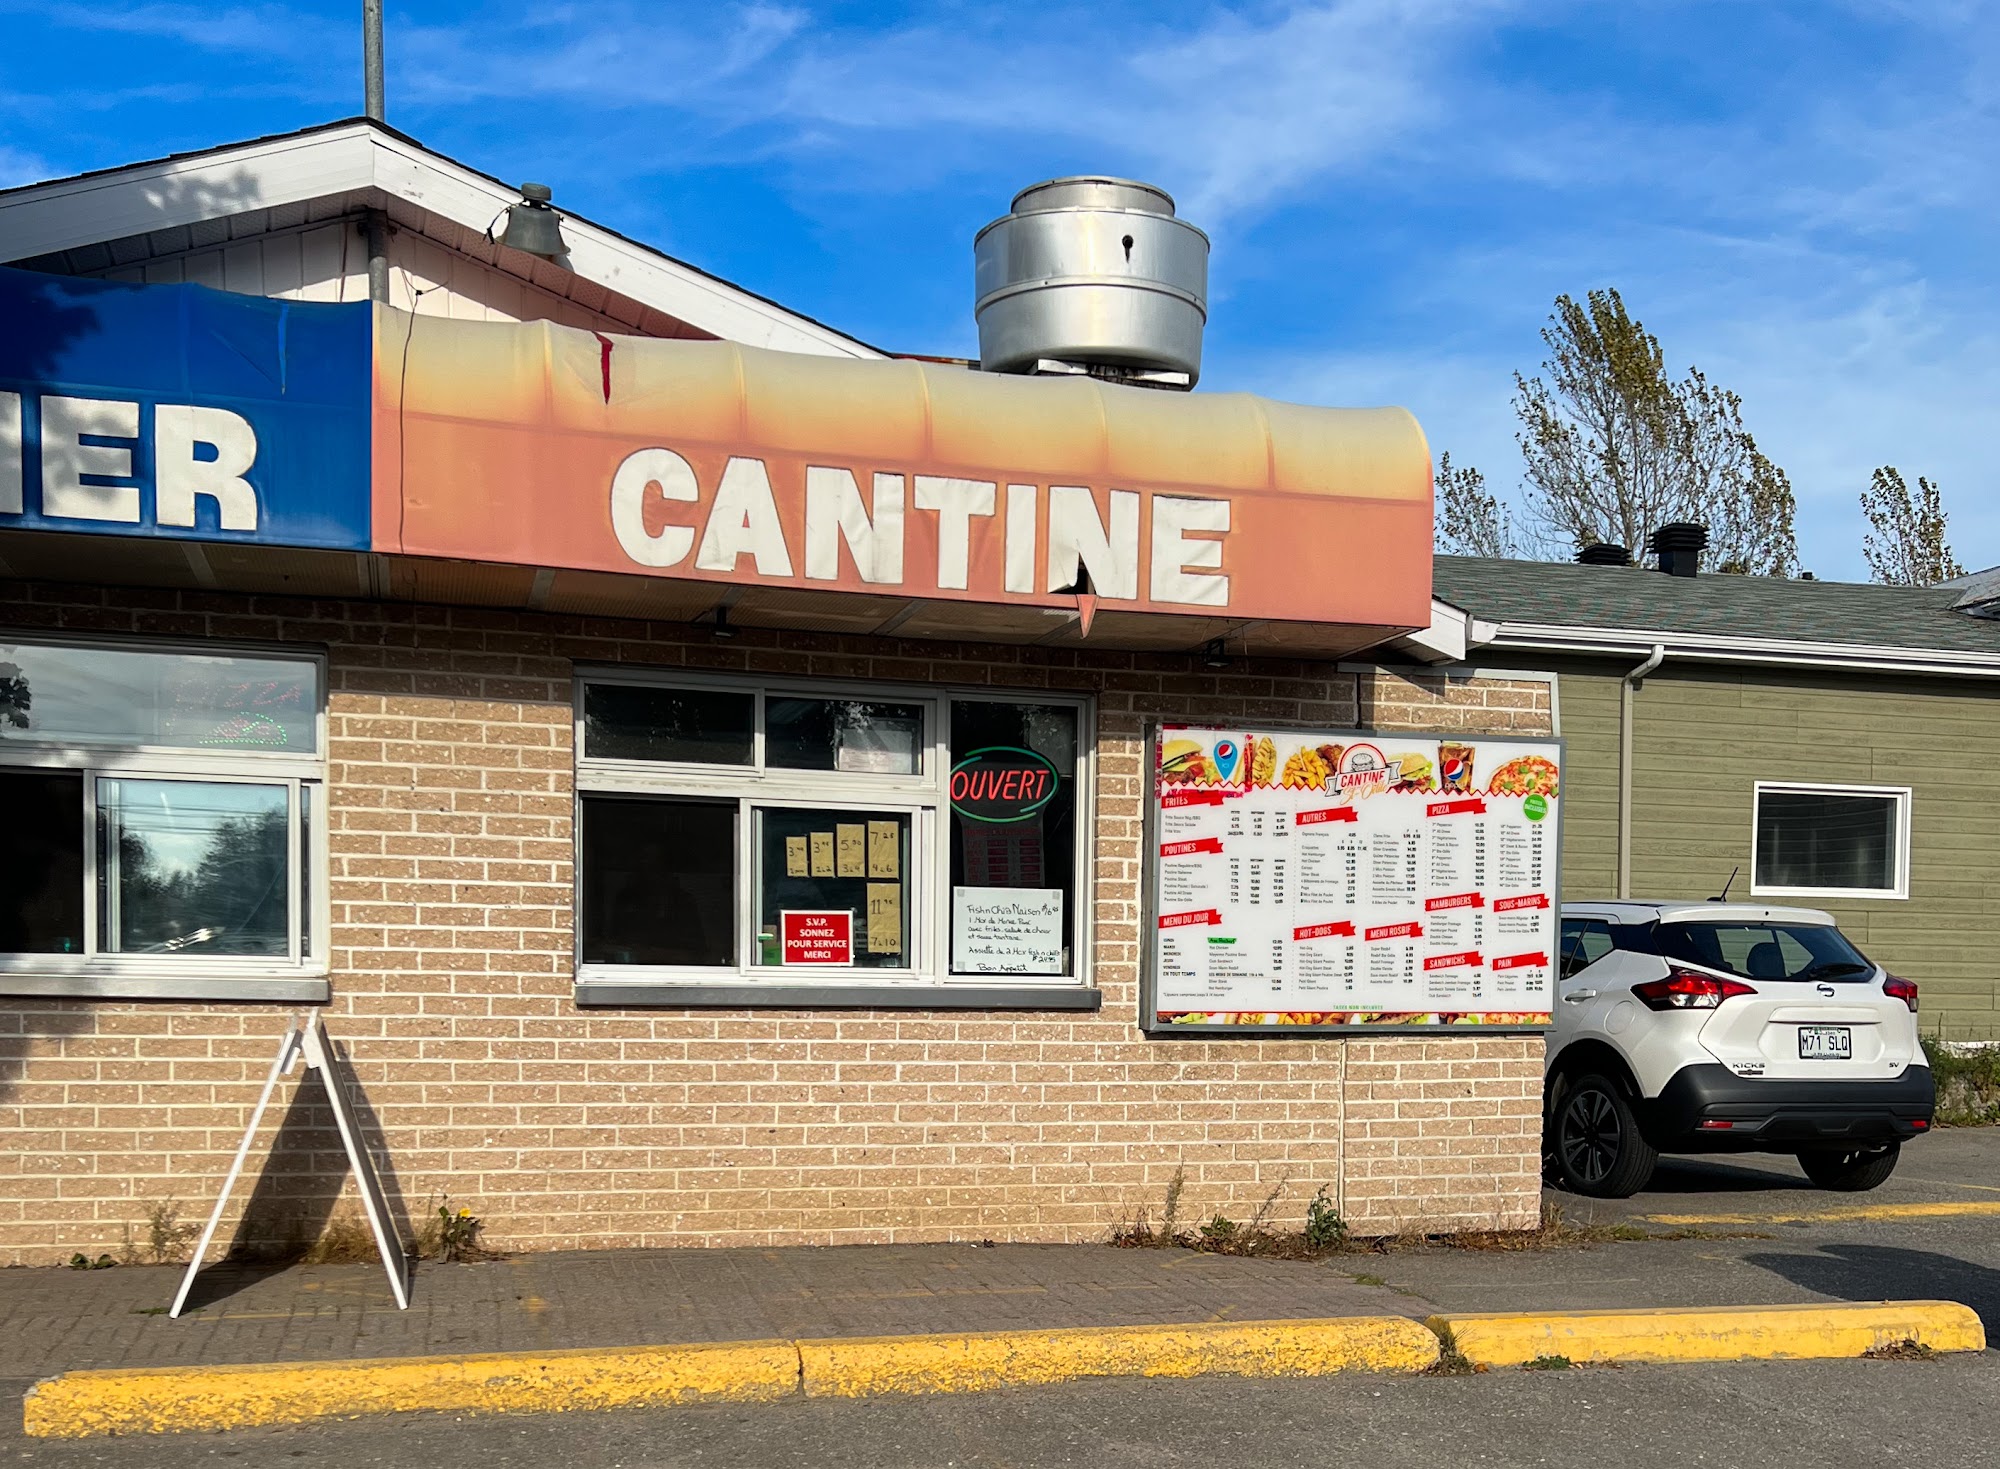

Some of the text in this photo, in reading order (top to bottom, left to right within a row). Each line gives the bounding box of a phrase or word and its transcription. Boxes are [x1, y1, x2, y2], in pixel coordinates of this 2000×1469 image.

[610, 447, 1232, 607] CANTINE
[1341, 770, 1385, 787] CANTINE
[950, 770, 1050, 800] OUVERT
[1165, 796, 1188, 807] FRITES
[1432, 805, 1450, 815] PIZZA
[1302, 812, 1327, 823] AUTRES
[1164, 843, 1196, 855] POUTINES
[1430, 896, 1472, 909] HAMBURGERS
[1499, 897, 1542, 910] SOUS-MARINS
[806, 918, 828, 926] S.V.P.
[1163, 913, 1209, 926] MENU DU JOUR
[800, 929, 834, 937] SONNEZ
[1300, 926, 1332, 938] HOT-DOGS
[1370, 925, 1412, 939] MENU ROSBIF
[976, 963, 997, 971] Bon
[1429, 955, 1465, 968] SANDWICHS
[1498, 958, 1512, 968] PAIN
[1802, 1035, 1848, 1050] M71 SLQ
